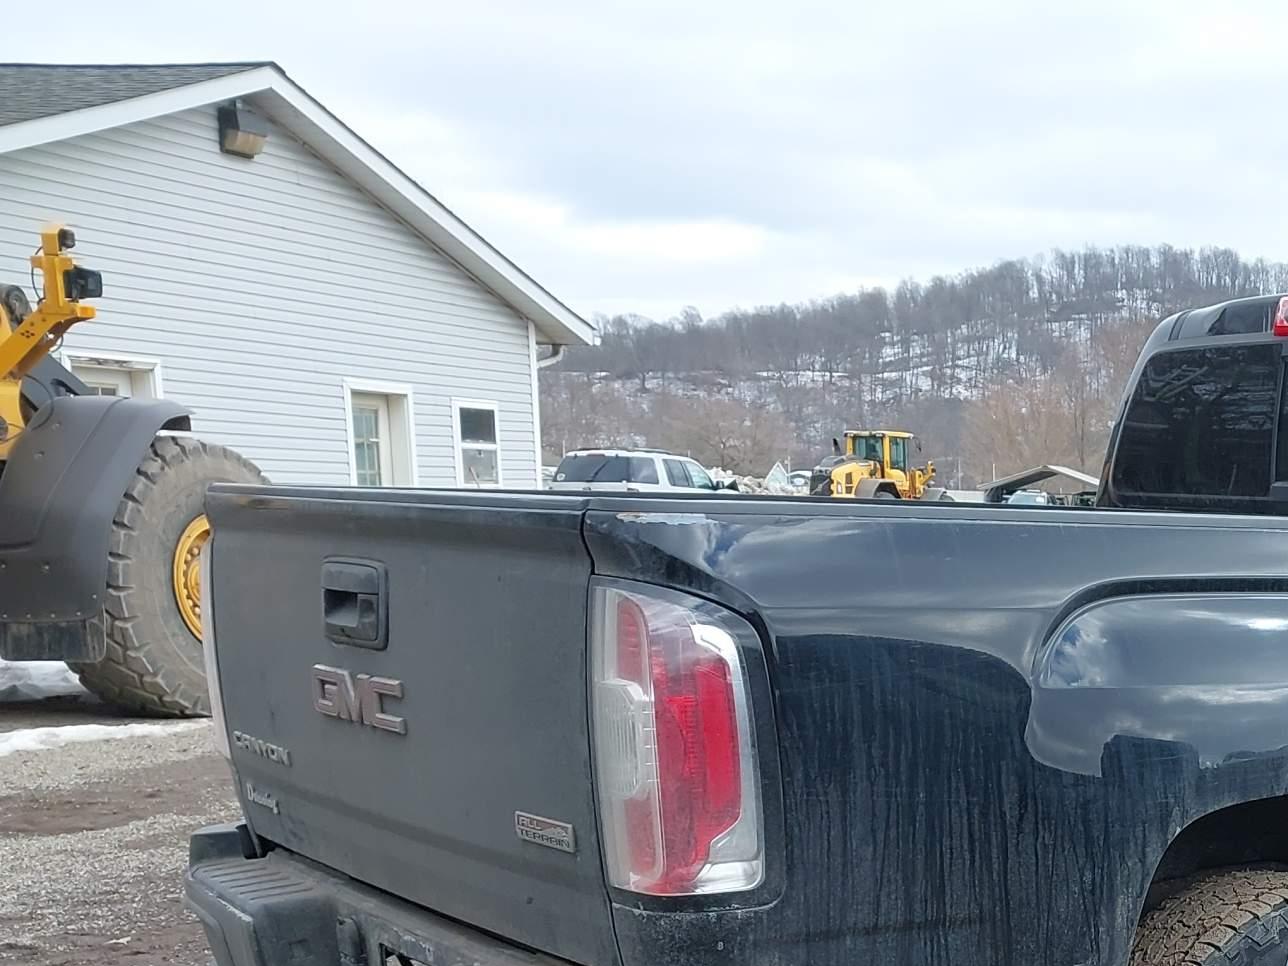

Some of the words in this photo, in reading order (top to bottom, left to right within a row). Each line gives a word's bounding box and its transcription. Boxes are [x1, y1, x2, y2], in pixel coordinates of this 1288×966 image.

[312, 663, 407, 735] GMC
[233, 730, 292, 767] CANYON
[518, 815, 543, 831] ALL
[520, 829, 570, 849] TERRAIN
